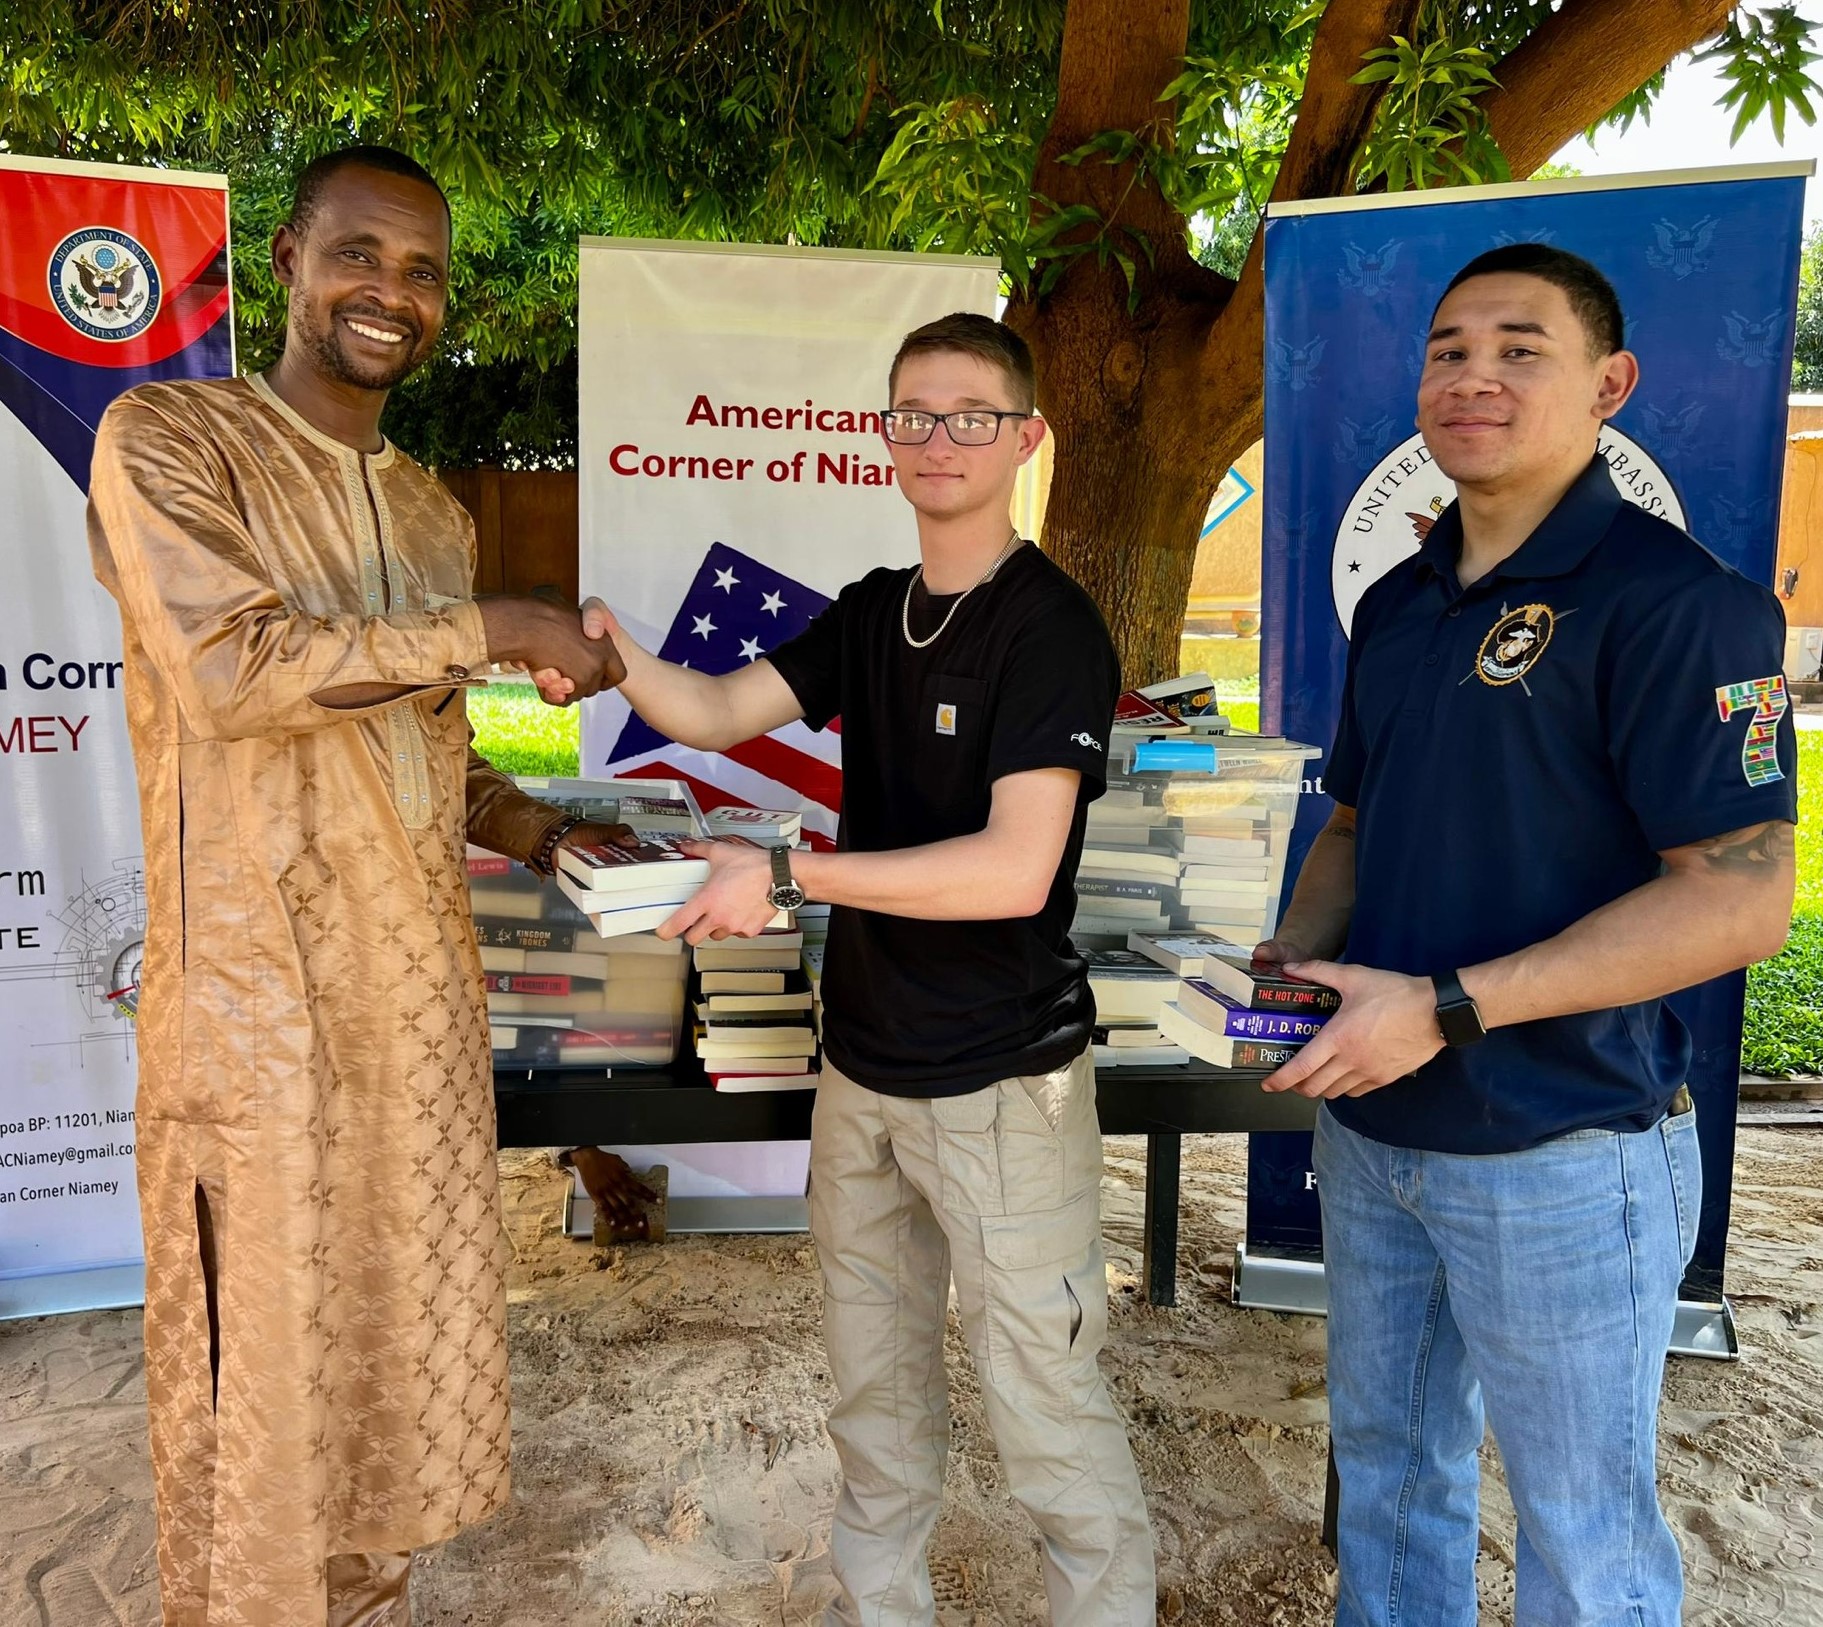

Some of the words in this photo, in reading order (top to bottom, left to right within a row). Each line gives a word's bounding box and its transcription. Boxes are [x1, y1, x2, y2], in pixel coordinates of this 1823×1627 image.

[56, 232, 114, 263] DEPARTMENT
[115, 234, 128, 247] OF
[129, 242, 153, 270] STATE
[53, 283, 78, 325] UNITED
[77, 318, 114, 339] STATES
[115, 326, 130, 339] OF
[131, 293, 158, 334] AMERICA
[686, 394, 882, 434] American
[609, 444, 754, 481] Corner
[766, 451, 808, 483] of
[1353, 445, 1433, 533] UNITED
[1075, 882, 1109, 892] THERAPIST
[516, 929, 551, 939] KINGDOM
[1258, 989, 1273, 1001] THE
[1275, 991, 1292, 1002] HOT
[1293, 992, 1315, 1004] ZONE
[1266, 1020, 1277, 1034] J.
[1279, 1021, 1292, 1034] D.
[28, 1116, 51, 1132] BP:
[55, 1112, 103, 1128] 11201,
[0, 1142, 136, 1168] ACNiamey@gmail.co
[20, 1185, 65, 1202] Corner
[68, 1180, 119, 1198] Niamey
